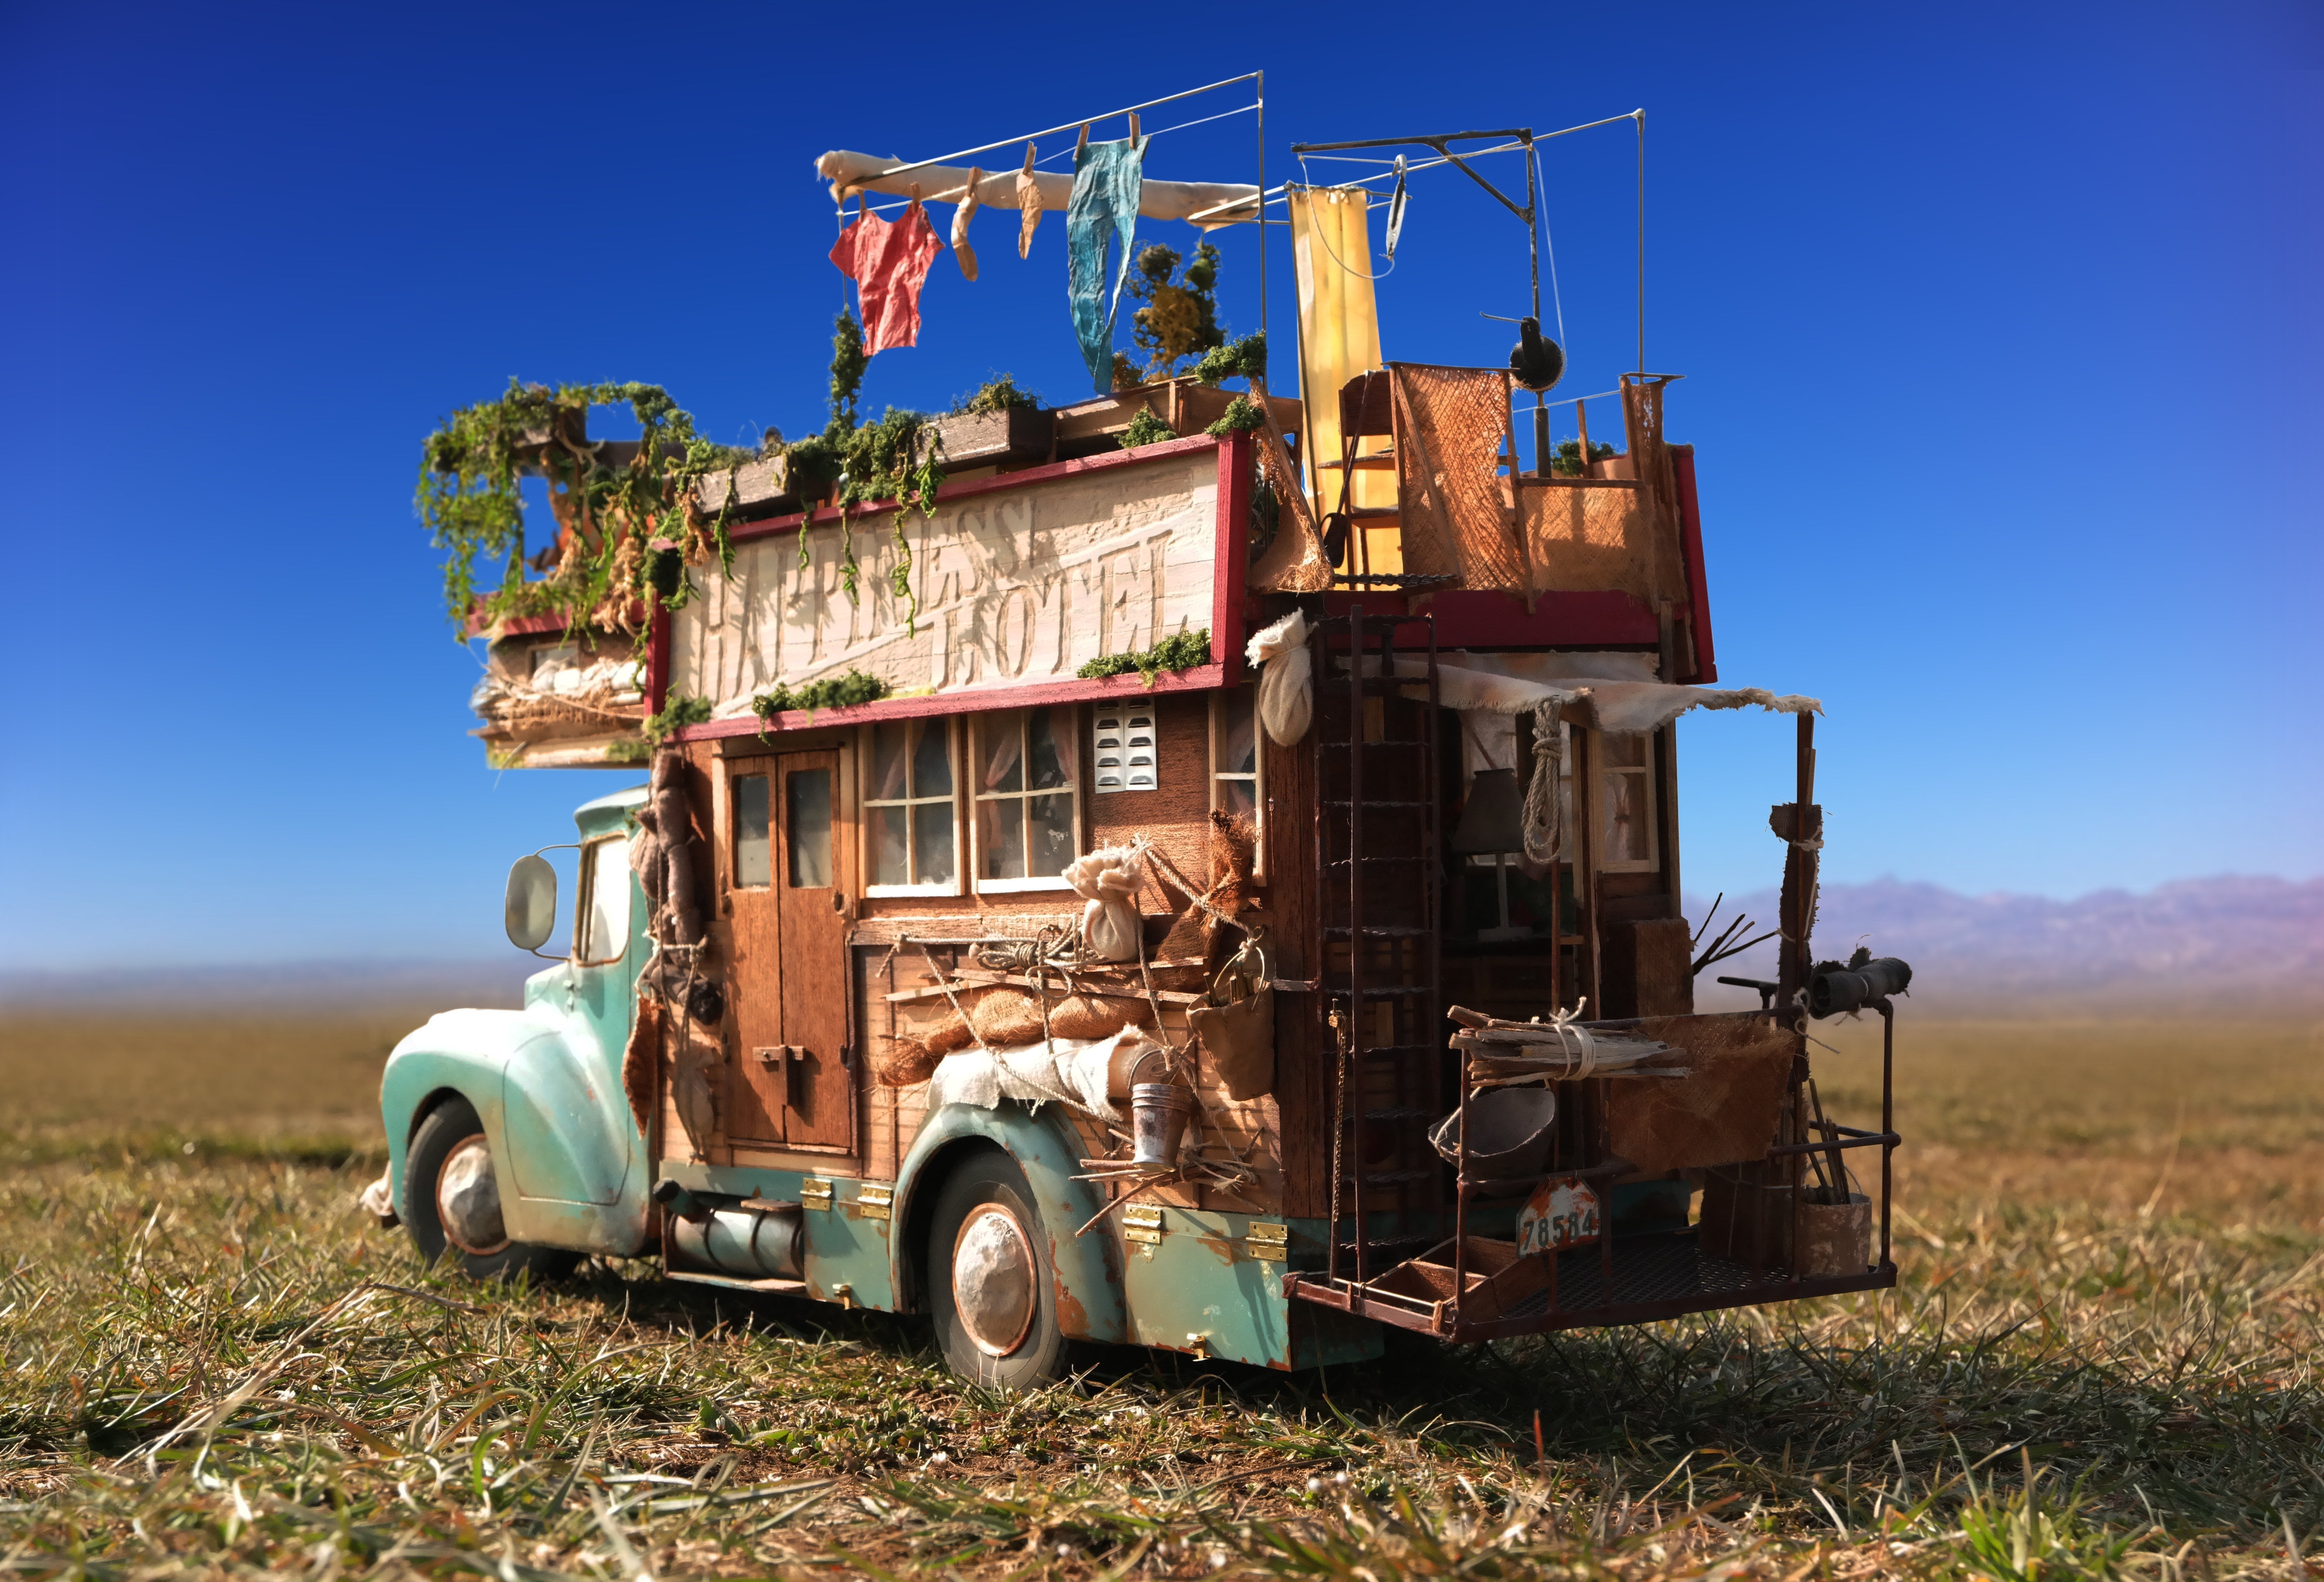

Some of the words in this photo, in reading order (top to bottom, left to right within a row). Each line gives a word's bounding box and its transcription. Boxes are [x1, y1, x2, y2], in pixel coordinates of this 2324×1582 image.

[696, 496, 1028, 706] HAPPINESS
[936, 529, 1189, 691] HOTEL
[1523, 1209, 1594, 1251] 78584
